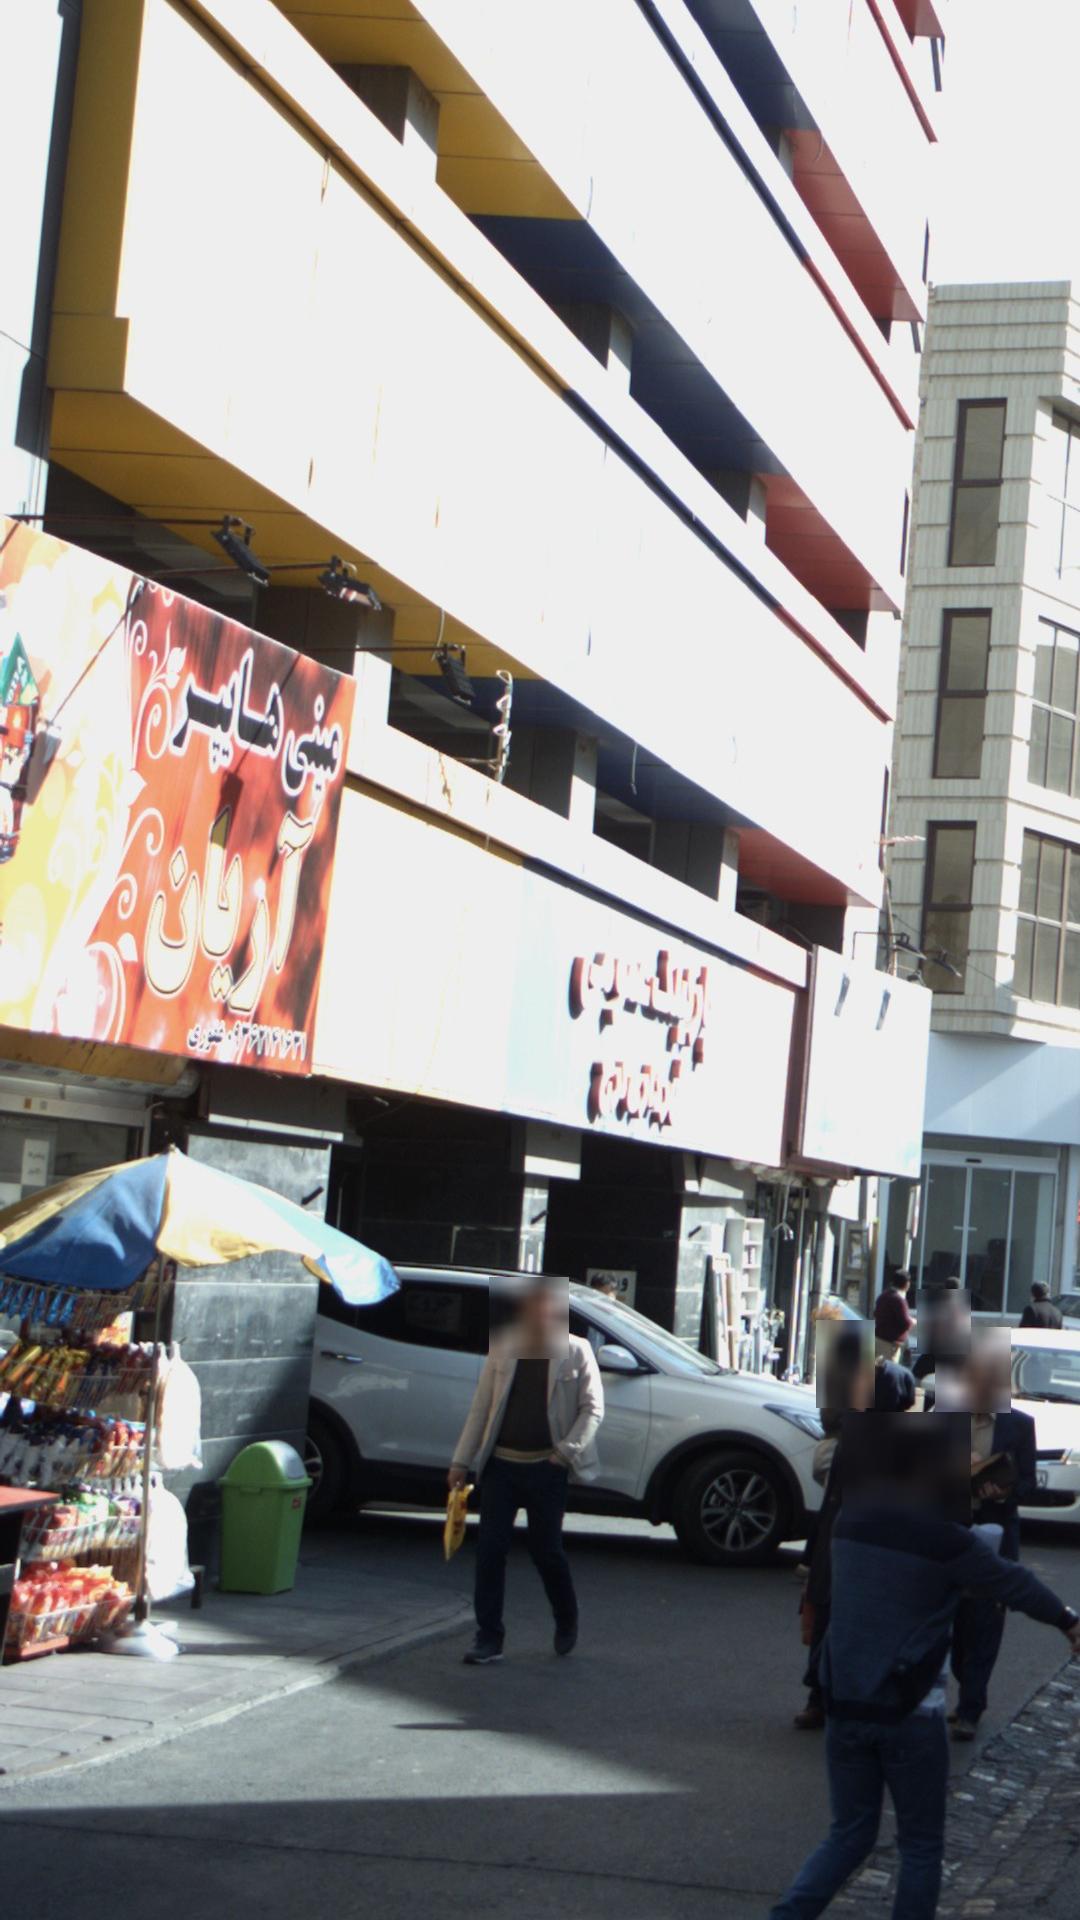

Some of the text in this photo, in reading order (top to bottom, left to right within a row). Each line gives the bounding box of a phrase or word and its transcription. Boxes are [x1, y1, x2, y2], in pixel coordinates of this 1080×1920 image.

[170, 647, 343, 796] مینی هایپر
[142, 806, 314, 1014] آریان
